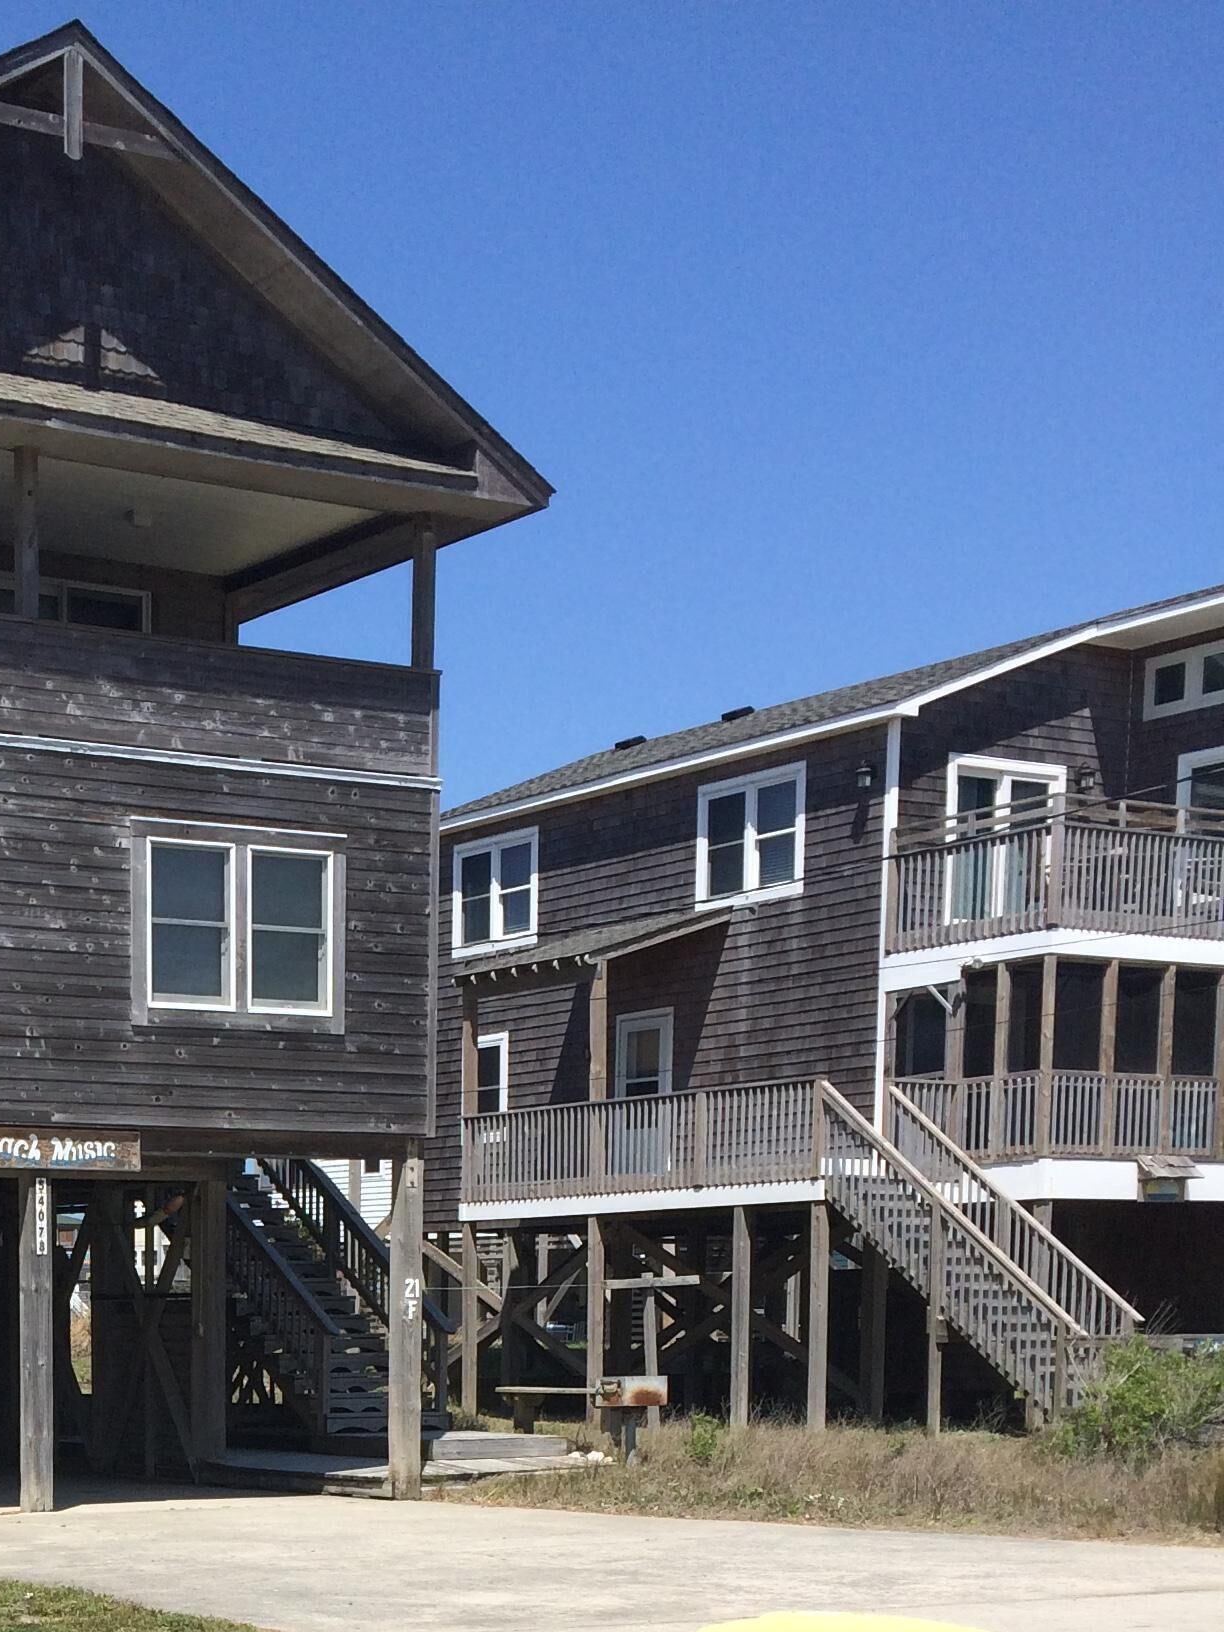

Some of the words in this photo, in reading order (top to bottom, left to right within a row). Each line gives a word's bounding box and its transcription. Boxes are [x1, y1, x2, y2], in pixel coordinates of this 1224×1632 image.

[50, 1137, 116, 1161] Music
[405, 1278, 420, 1298] 21
[408, 1300, 418, 1320] F
